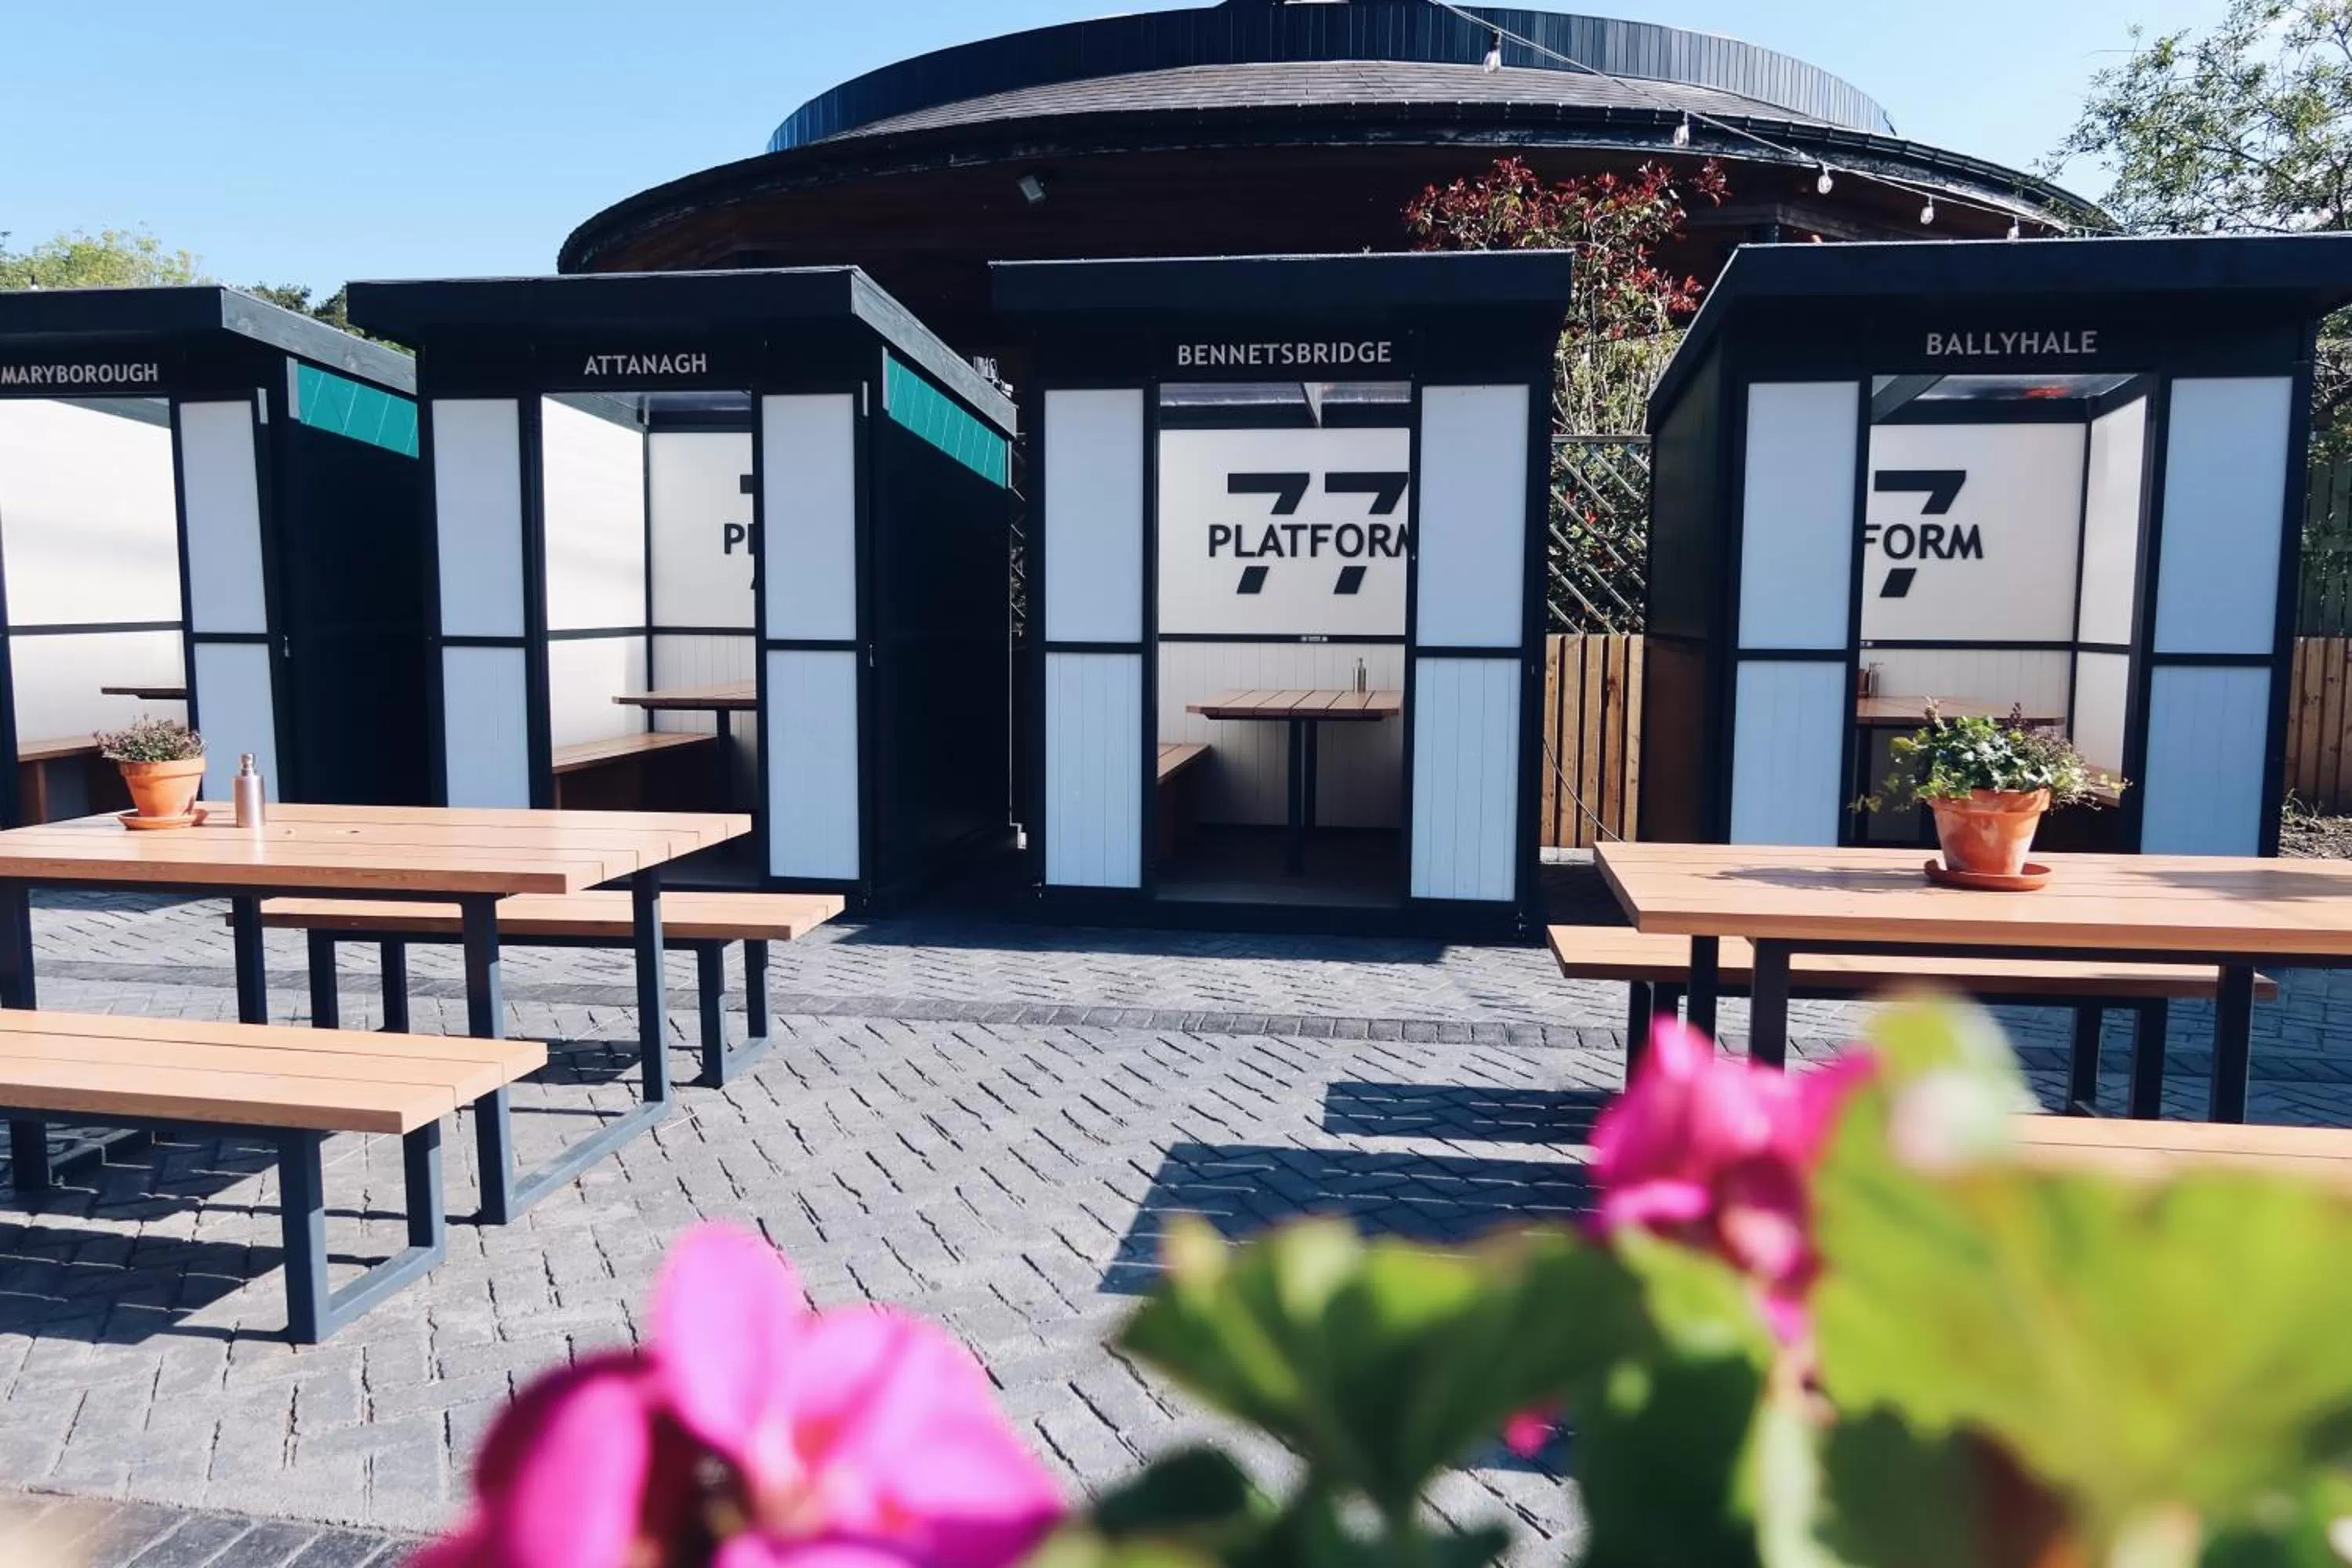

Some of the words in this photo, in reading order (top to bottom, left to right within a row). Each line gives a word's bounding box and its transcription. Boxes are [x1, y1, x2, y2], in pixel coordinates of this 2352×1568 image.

[1178, 341, 1392, 365] BENNETSBRIDGE
[1926, 330, 2098, 356] BALLYHALE
[1, 363, 158, 384] MARYBOROUGH
[584, 353, 707, 376] ATTANAGH
